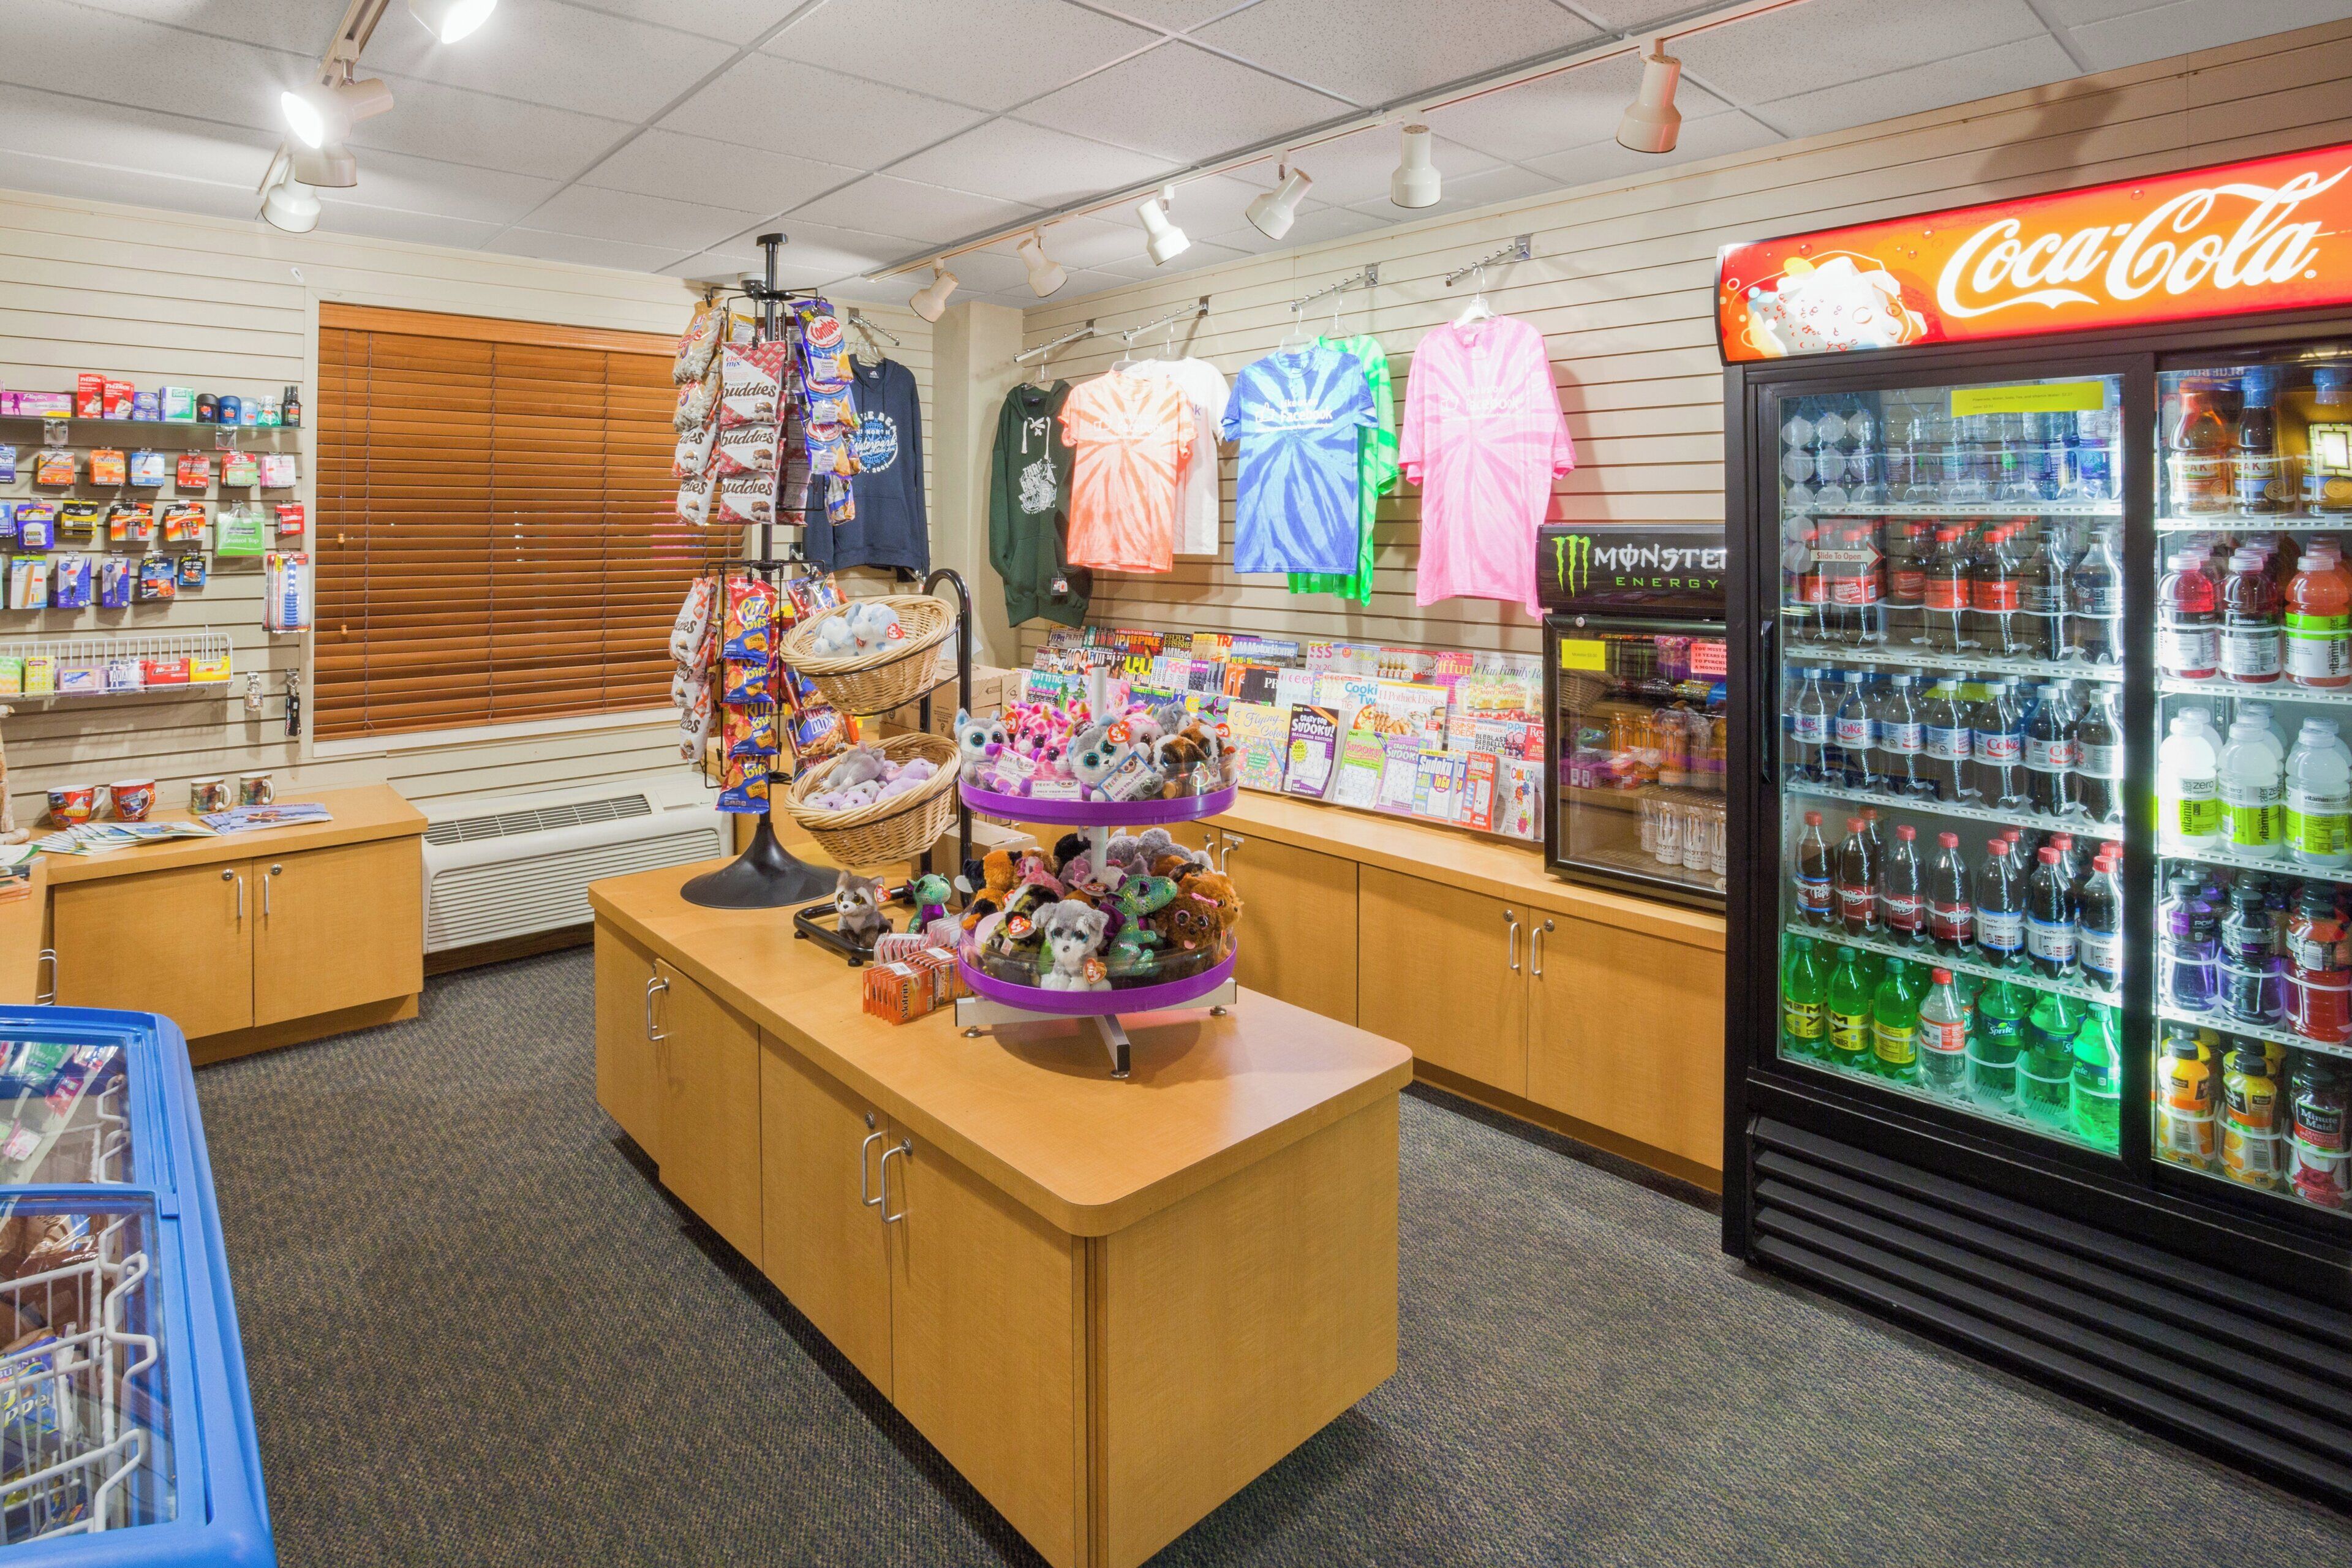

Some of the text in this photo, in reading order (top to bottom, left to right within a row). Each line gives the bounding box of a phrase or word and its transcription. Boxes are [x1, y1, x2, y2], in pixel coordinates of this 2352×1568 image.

[811, 319, 840, 341] Combos
[1816, 551, 1834, 560] Slide
[1843, 552, 1862, 562] Open
[1616, 576, 1719, 589] ENERGY
[739, 598, 770, 617] RITZ
[744, 617, 767, 631] bits
[1248, 644, 1295, 657] MotorHome
[744, 666, 767, 679] bits
[1499, 664, 1528, 680] Family
[1344, 682, 1378, 696] Cooki
[1341, 700, 1353, 710] 116
[1358, 695, 1376, 705] Tw
[1387, 691, 1444, 706] Potluck Dishes
[811, 714, 833, 734] mix
[1245, 710, 1284, 727] Flying
[1300, 714, 1328, 726] CRAZY FOR
[1291, 718, 1335, 737] SUDOKU!
[1838, 722, 1863, 734] Coke
[1986, 737, 2019, 750] Coke
[1386, 747, 1419, 761] SUDOK
[744, 763, 767, 779] bits
[1419, 756, 1453, 776] Sudoku
[2193, 779, 2214, 790] zero
[1683, 848, 1709, 856] ONSTER
[1988, 1025, 2014, 1036] Sprite
[2301, 1107, 2339, 1125] Minute
[2305, 1118, 2333, 1132] Maid
